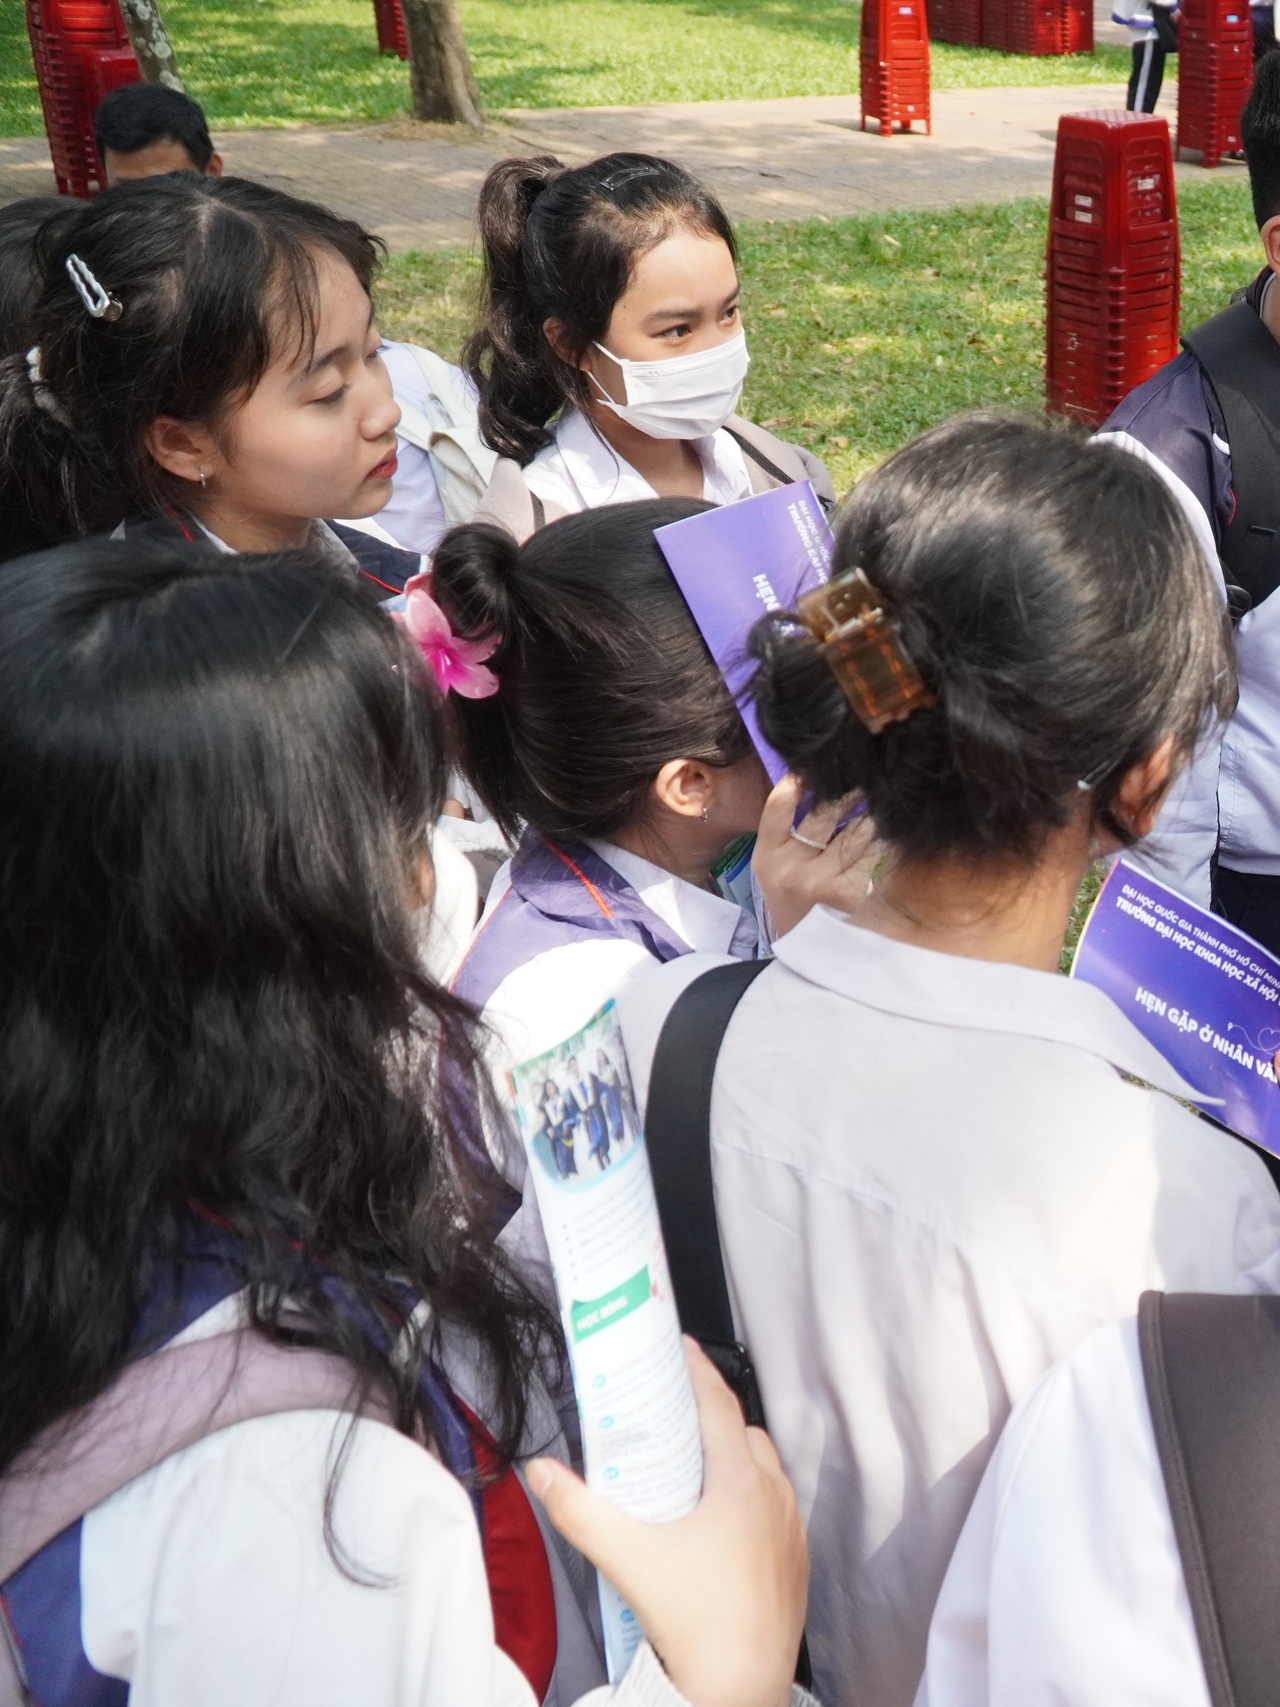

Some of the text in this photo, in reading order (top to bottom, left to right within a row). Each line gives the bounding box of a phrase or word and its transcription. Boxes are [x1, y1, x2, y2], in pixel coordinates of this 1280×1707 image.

[788, 503, 812, 548] TRƯỜNG
[753, 573, 781, 611] HẸN
[1116, 896, 1157, 928] TRƯỜNG
[1155, 921, 1174, 938] ĐẠI
[1172, 931, 1196, 951] HỌC
[1194, 944, 1222, 968] KHOA
[1221, 961, 1245, 980] HỌC
[1242, 974, 1261, 990] XÃ
[1258, 984, 1279, 1002] HỘI
[1121, 884, 1138, 898] ĐẠI
[1136, 893, 1156, 909] HỌC
[1154, 904, 1179, 924] QUỐC
[1177, 919, 1193, 932] GIA
[1192, 927, 1220, 948] THÀNH
[1218, 943, 1238, 958] PHỐ
[1236, 954, 1251, 966] HỒ
[1249, 963, 1267, 976] CHÍ
[1135, 987, 1279, 1084] HẸN GẶP Ở NHÂN VĂ
